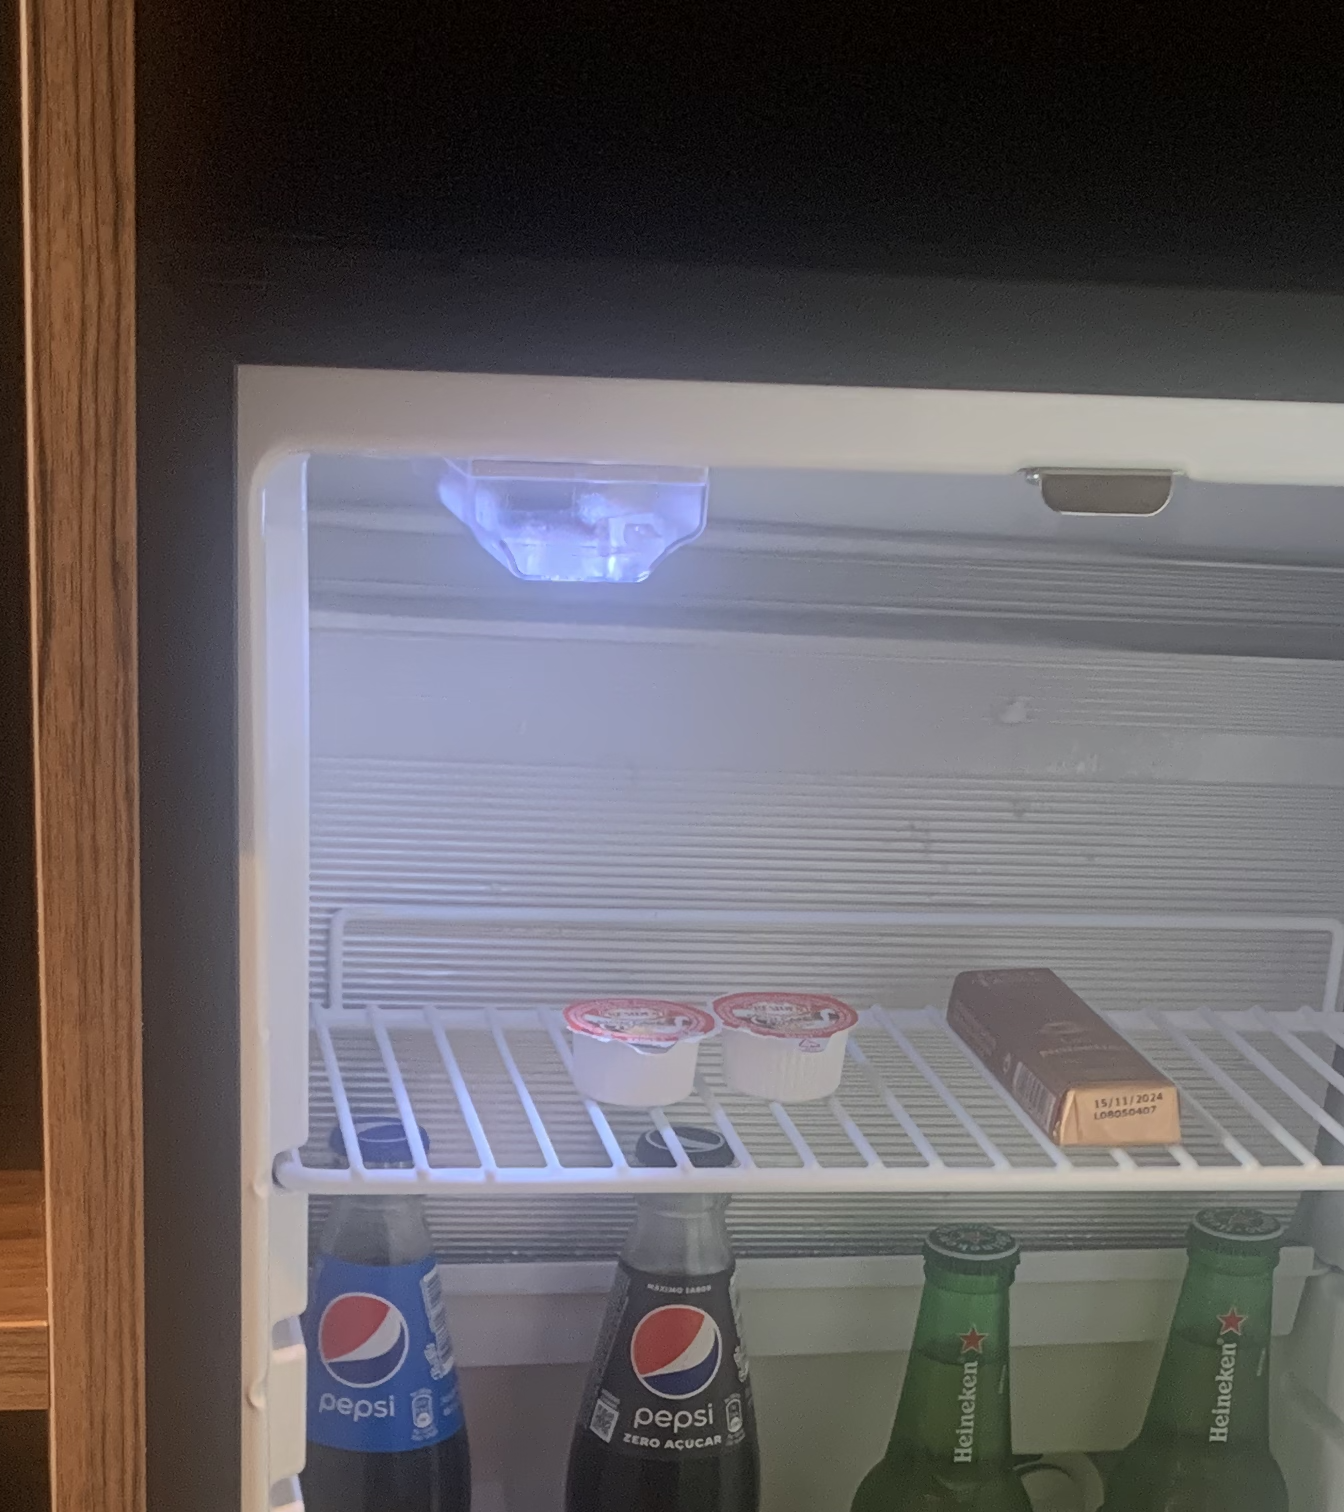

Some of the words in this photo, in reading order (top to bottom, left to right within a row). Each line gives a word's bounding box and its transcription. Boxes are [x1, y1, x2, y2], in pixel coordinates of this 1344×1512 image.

[1094, 1092, 1163, 1109] 15/11/2024
[318, 1393, 396, 1422] pepsi
[1209, 1342, 1238, 1443] Heineken
[633, 1403, 714, 1434] pepsi
[954, 1360, 978, 1463] Heineken
[623, 1432, 661, 1449] ZERO
